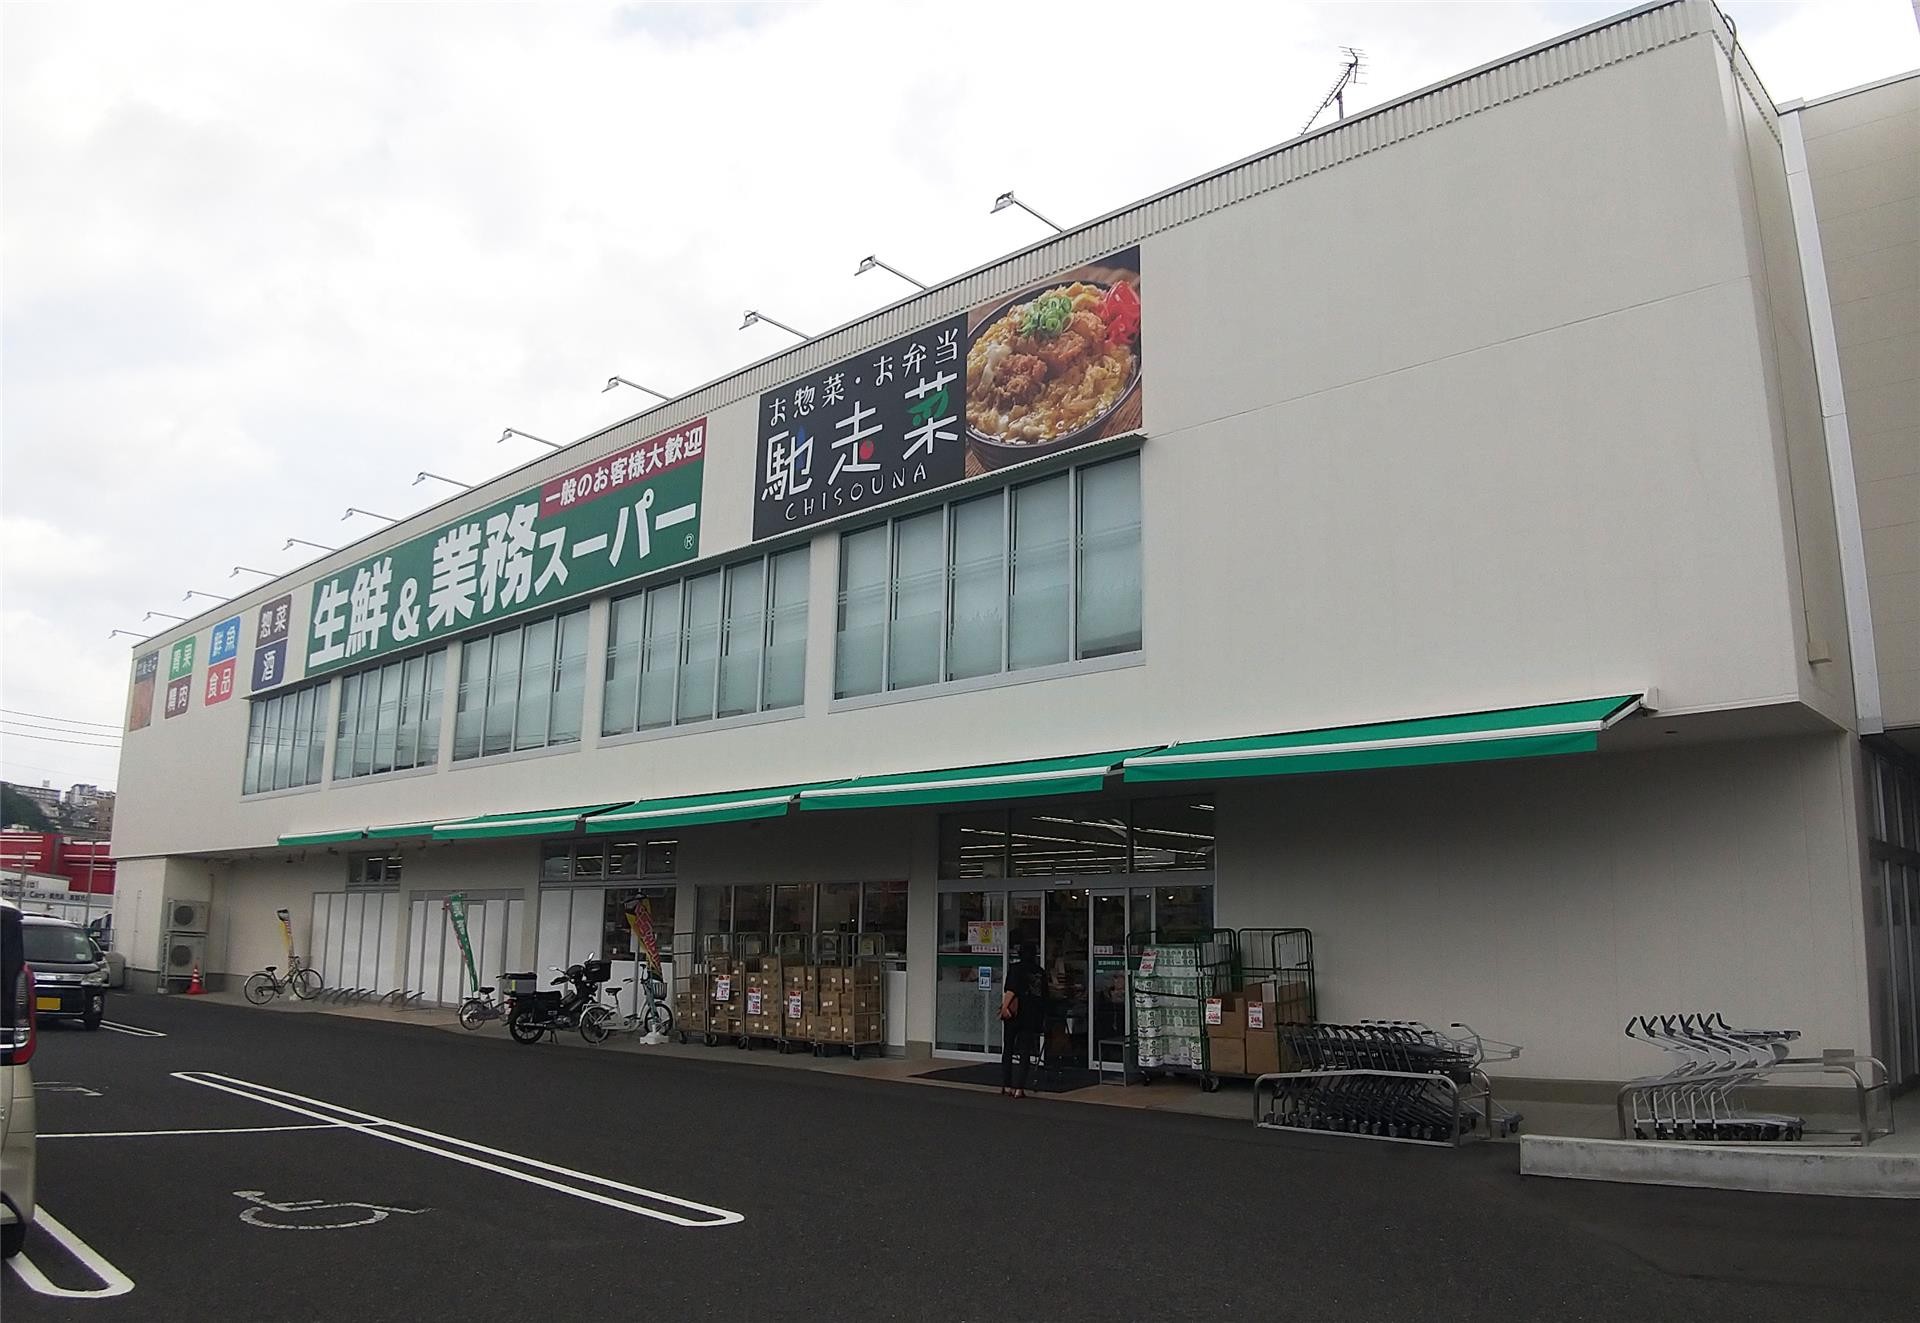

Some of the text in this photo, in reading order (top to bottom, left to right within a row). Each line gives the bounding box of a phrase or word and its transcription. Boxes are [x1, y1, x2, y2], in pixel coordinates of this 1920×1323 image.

[769, 328, 959, 427] お惣菜・お弁当
[761, 371, 960, 501] 馳走菜
[546, 426, 703, 506] 一般のお客様大歓迎
[785, 462, 929, 521] CHISOUNA
[260, 604, 288, 640] 惣菜
[207, 668, 231, 699] 食品
[261, 650, 276, 682] 酒
